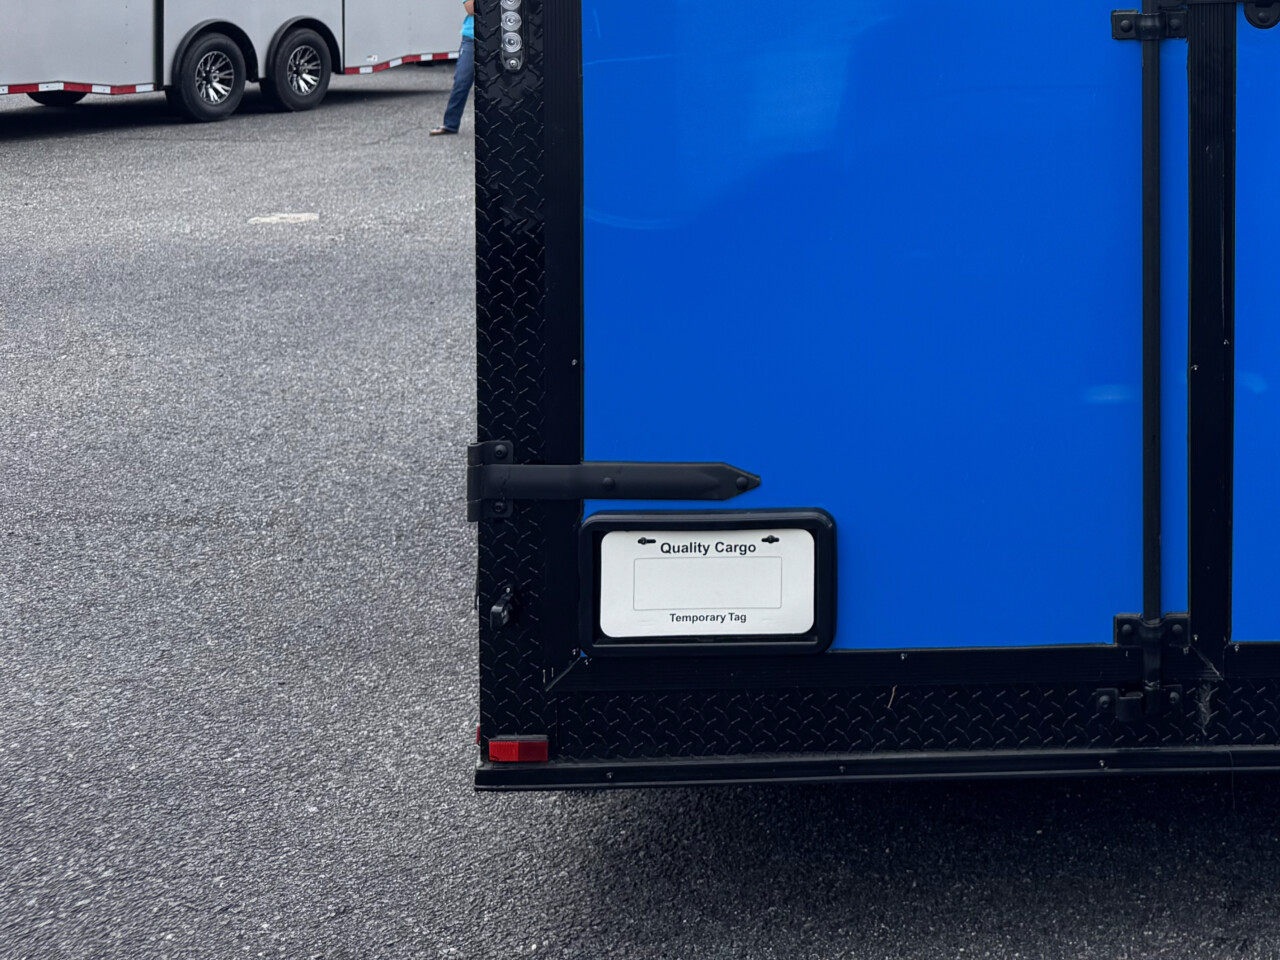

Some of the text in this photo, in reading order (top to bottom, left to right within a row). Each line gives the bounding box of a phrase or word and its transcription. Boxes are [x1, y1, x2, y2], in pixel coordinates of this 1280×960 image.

[660, 541, 756, 556] Quality Cargo
[670, 612, 747, 624] Temporary Tag
